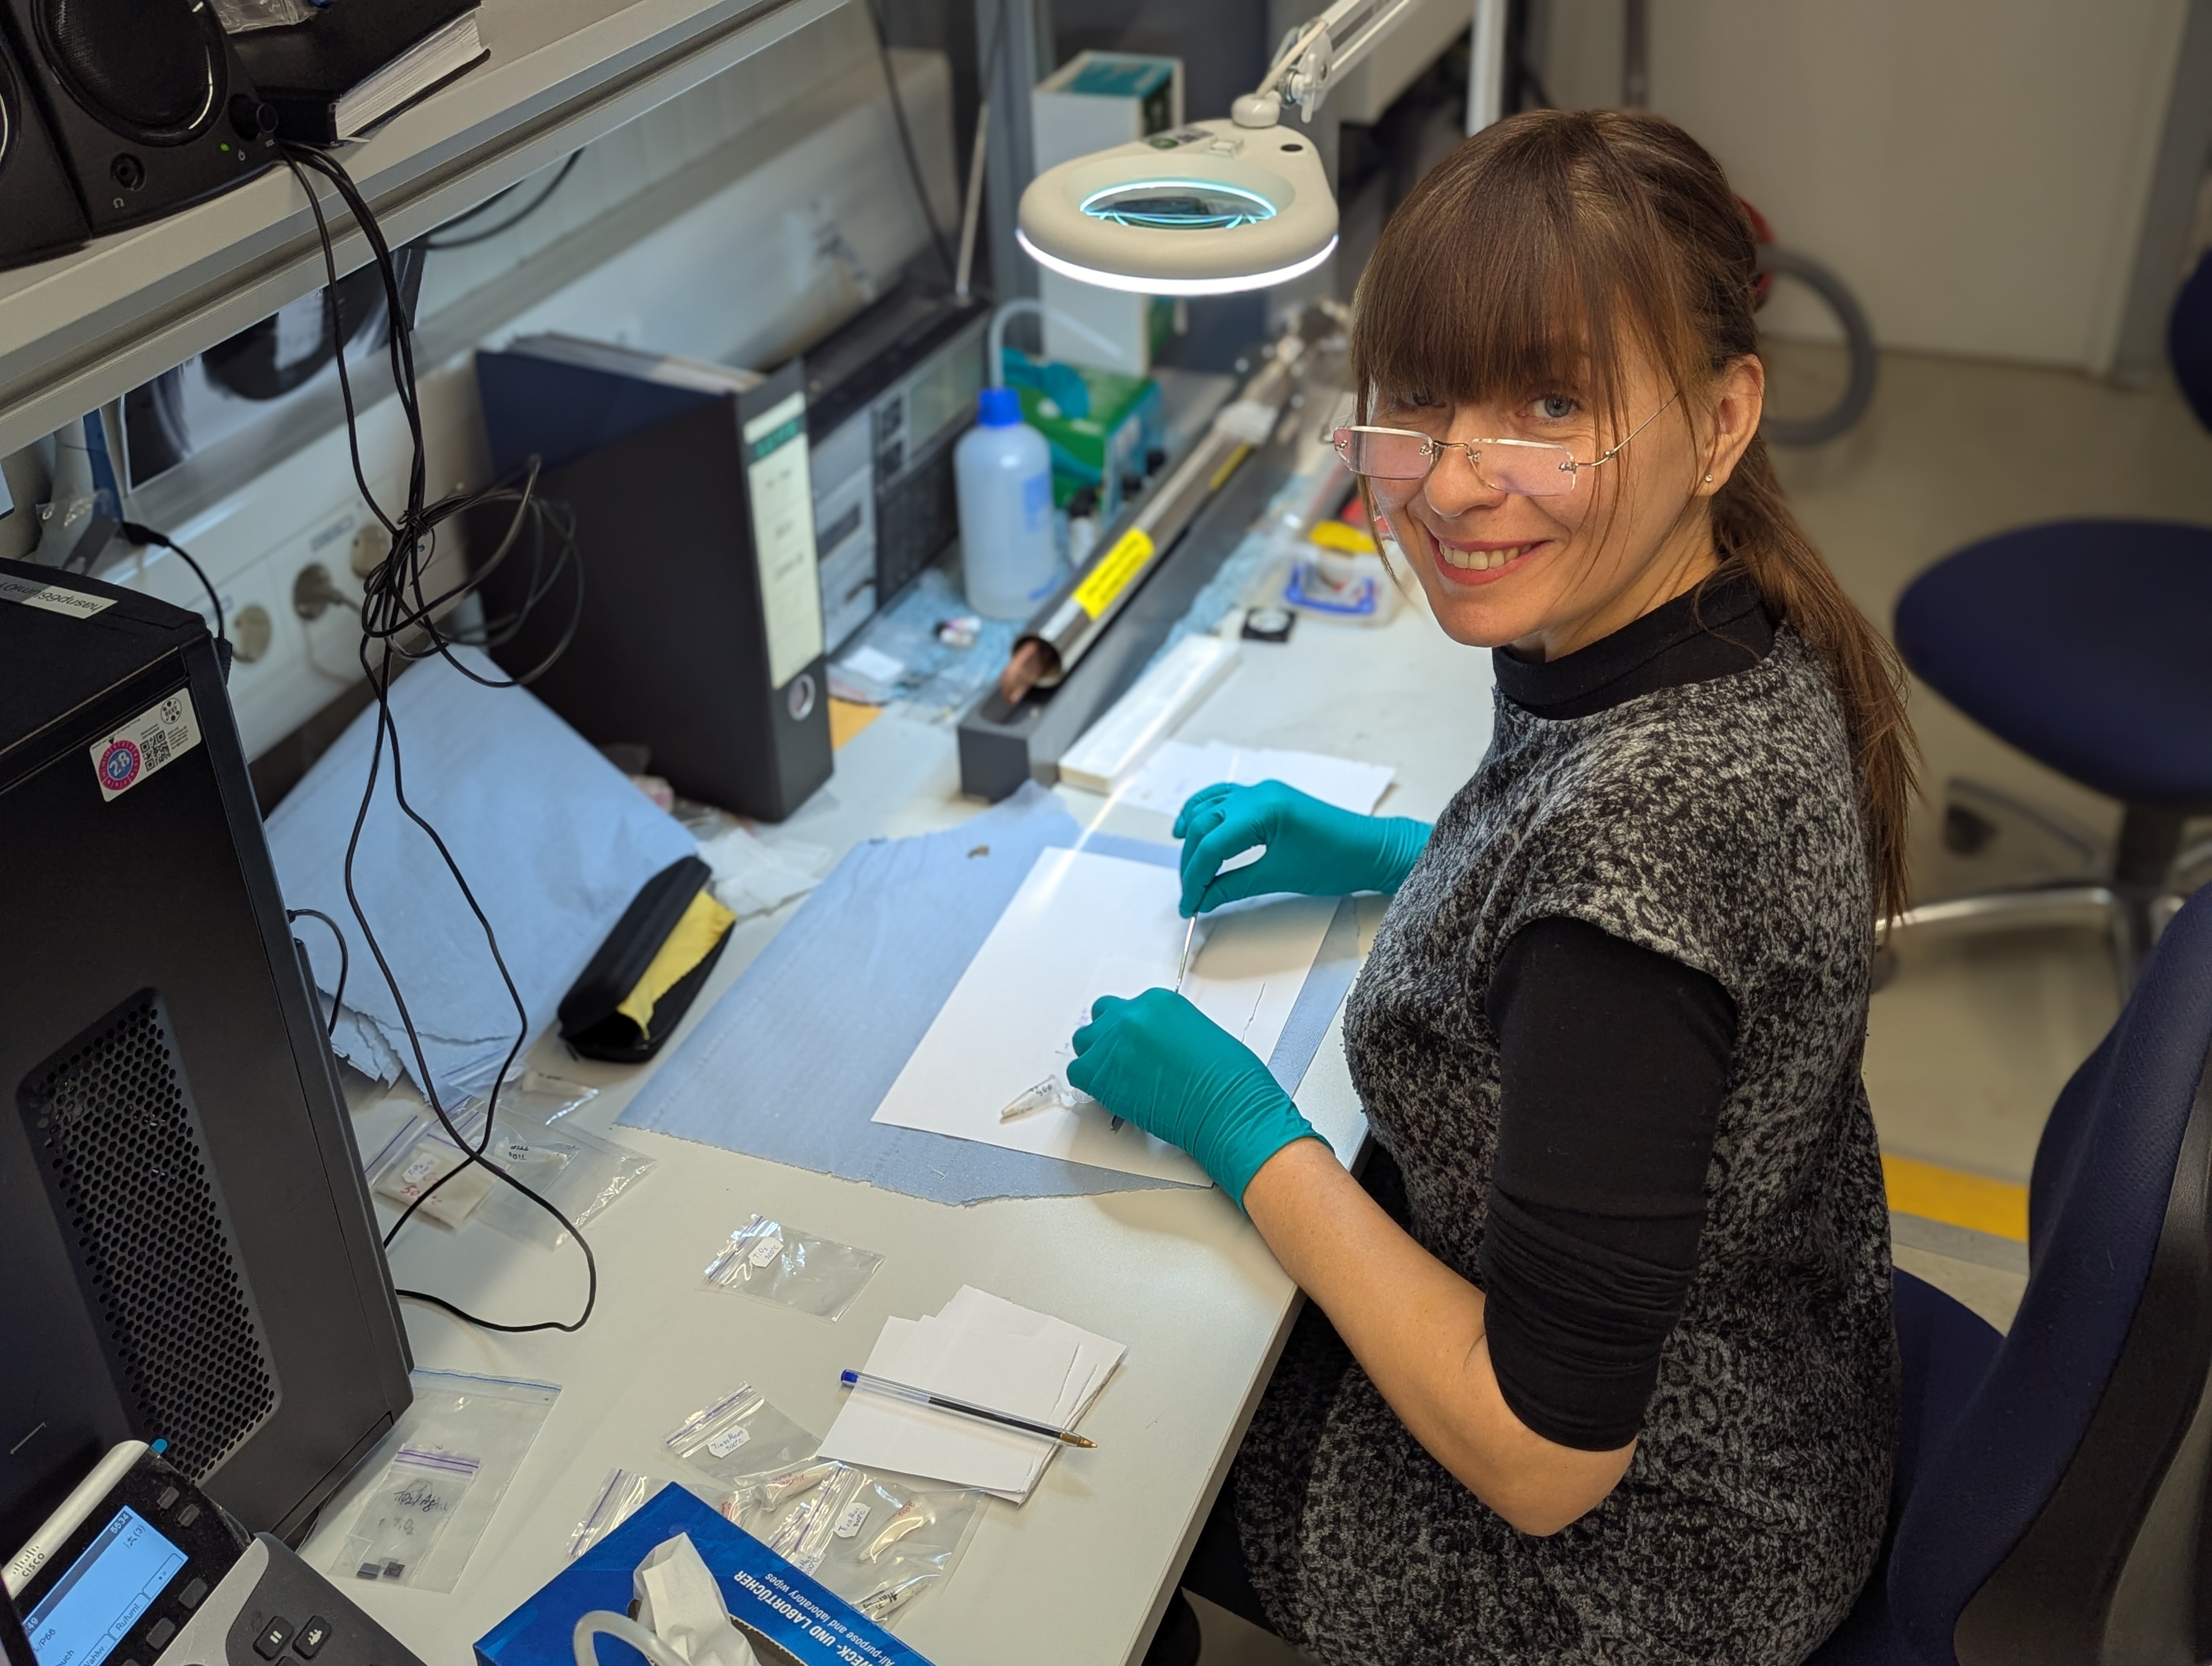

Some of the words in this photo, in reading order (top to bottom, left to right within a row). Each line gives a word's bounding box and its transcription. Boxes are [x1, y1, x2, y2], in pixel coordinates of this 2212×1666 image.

[110, 752, 130, 777] 28
[753, 1247, 769, 1259] TiO2
[110, 1512, 130, 1534] 5534
[765, 1572, 790, 1592] wipes
[734, 1570, 814, 1630] LABORTÜCHER
[788, 1589, 831, 1624] laboratory
[808, 1627, 837, 1647] UND
[826, 1619, 847, 1634] and
[846, 1631, 895, 1666] All-purpose
